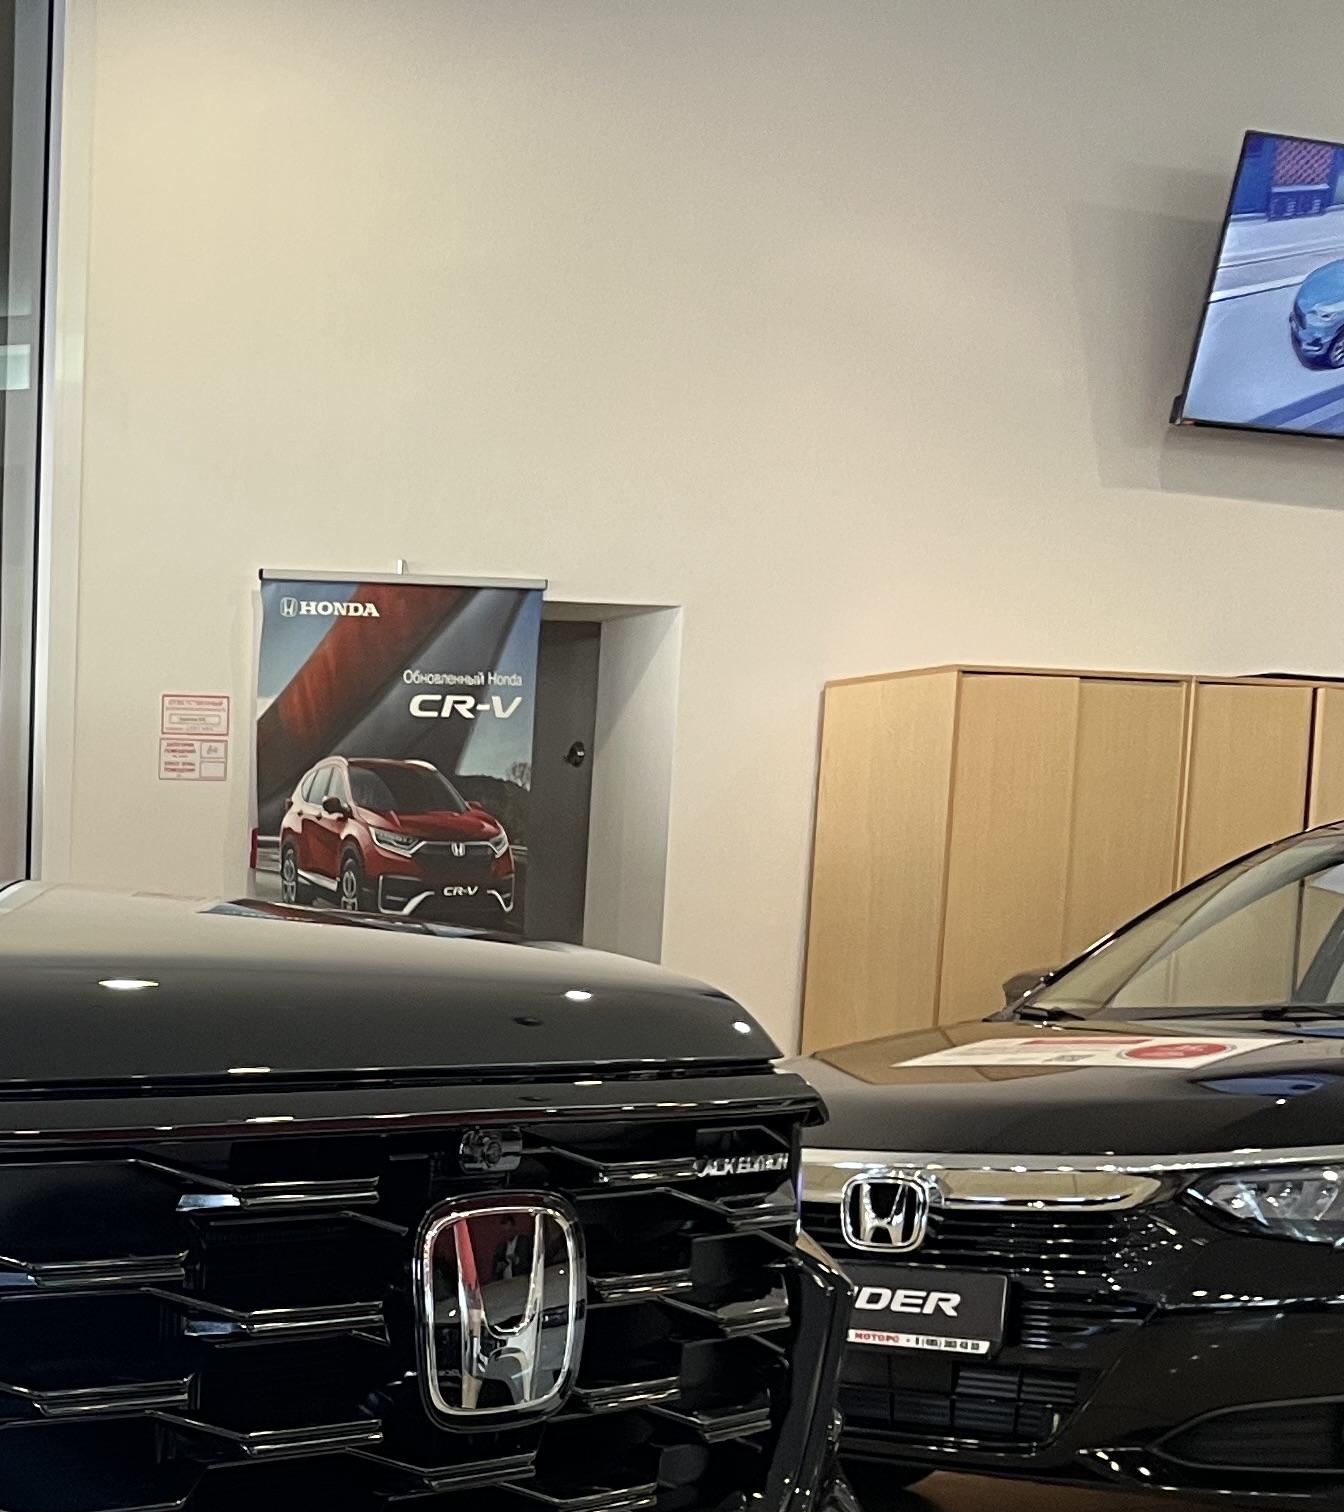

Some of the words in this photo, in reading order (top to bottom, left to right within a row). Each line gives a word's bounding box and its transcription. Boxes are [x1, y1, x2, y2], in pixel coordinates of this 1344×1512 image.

[299, 600, 381, 618] HONDA
[402, 668, 485, 688] Обновленный
[487, 672, 523, 687] Honda
[409, 694, 524, 719] CR-V
